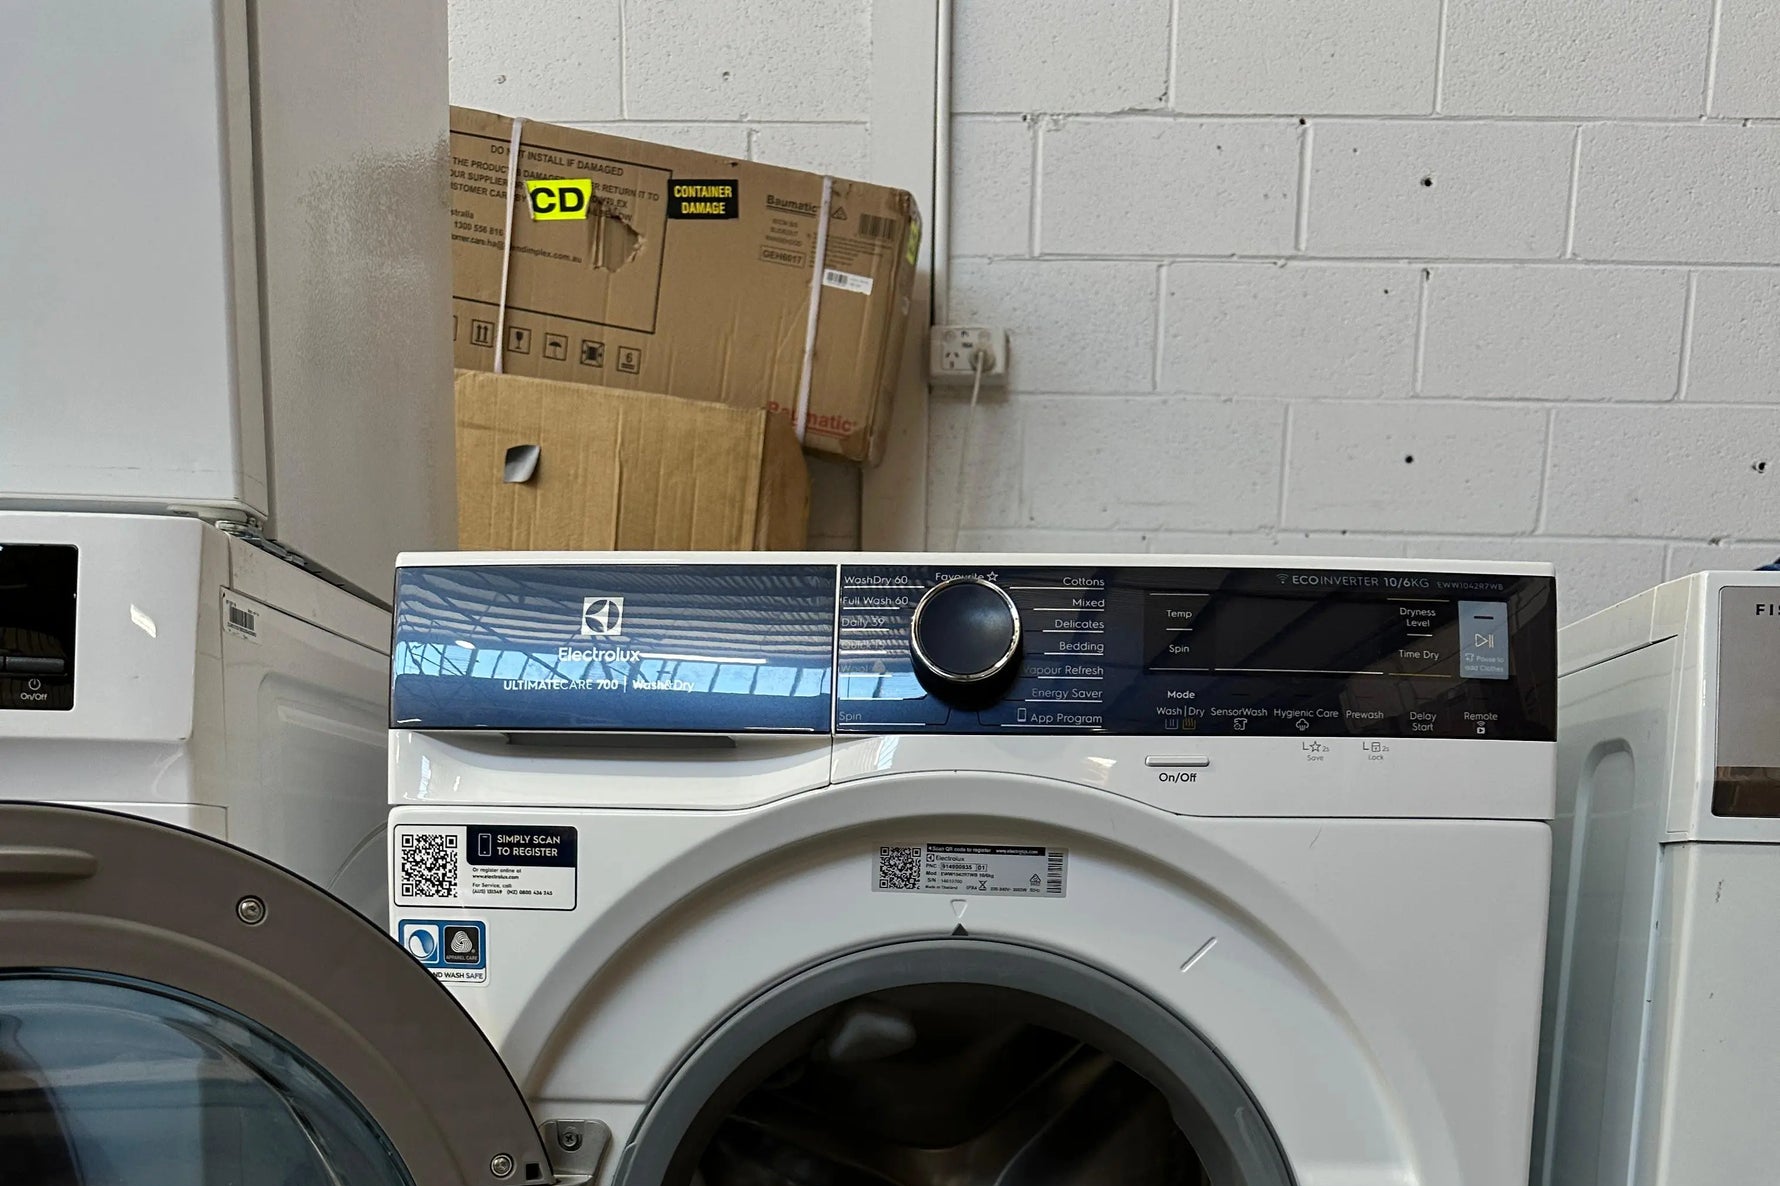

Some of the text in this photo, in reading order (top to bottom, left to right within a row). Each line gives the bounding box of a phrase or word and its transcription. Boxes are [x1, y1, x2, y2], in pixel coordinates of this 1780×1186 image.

[491, 145, 504, 154] DO
[528, 151, 564, 166] INSTALL
[577, 161, 623, 176] DAMAGED
[453, 157, 469, 166] THE
[602, 184, 636, 195] RETURN
[648, 192, 659, 201] TO
[674, 186, 732, 197] CONTAINER
[530, 187, 585, 213] CD
[766, 195, 817, 212] Baumatic
[681, 202, 726, 214] DAMAGE
[845, 576, 908, 585] WashDry 60
[1063, 577, 1104, 586] Cottons
[1292, 575, 1429, 588] ECOINVERTER 10/6KG
[843, 597, 908, 605] Full Wash 60
[1072, 599, 1105, 607] Mixed
[1166, 609, 1192, 621] Temp
[1400, 607, 1436, 617] Dryness
[841, 618, 868, 628] Daily
[1055, 619, 1104, 629] Delicates
[1407, 618, 1430, 627] Level
[1060, 642, 1104, 653] Bedding
[1168, 644, 1190, 655] Spin
[558, 646, 640, 663] Electrolux
[1399, 650, 1439, 661] Time Dry
[1065, 665, 1103, 675] Refresh
[503, 679, 618, 690] ULTIMATECARE 700
[20, 692, 47, 701] On/Off
[1032, 688, 1103, 699] Energy Saver
[1168, 691, 1195, 699] Mode
[839, 712, 862, 722] Spin
[1211, 708, 1268, 716] SensorWash
[1274, 709, 1339, 718] Hygienic Care
[1346, 710, 1384, 719] Prewash
[1410, 712, 1437, 722] Delay
[1464, 712, 1498, 720] Remote
[1031, 714, 1102, 724] App Program
[1412, 723, 1433, 731] Start
[1159, 772, 1197, 783] On/Off
[497, 835, 560, 844] SIMPLY SCAN
[497, 847, 558, 857] TO REGISTER
